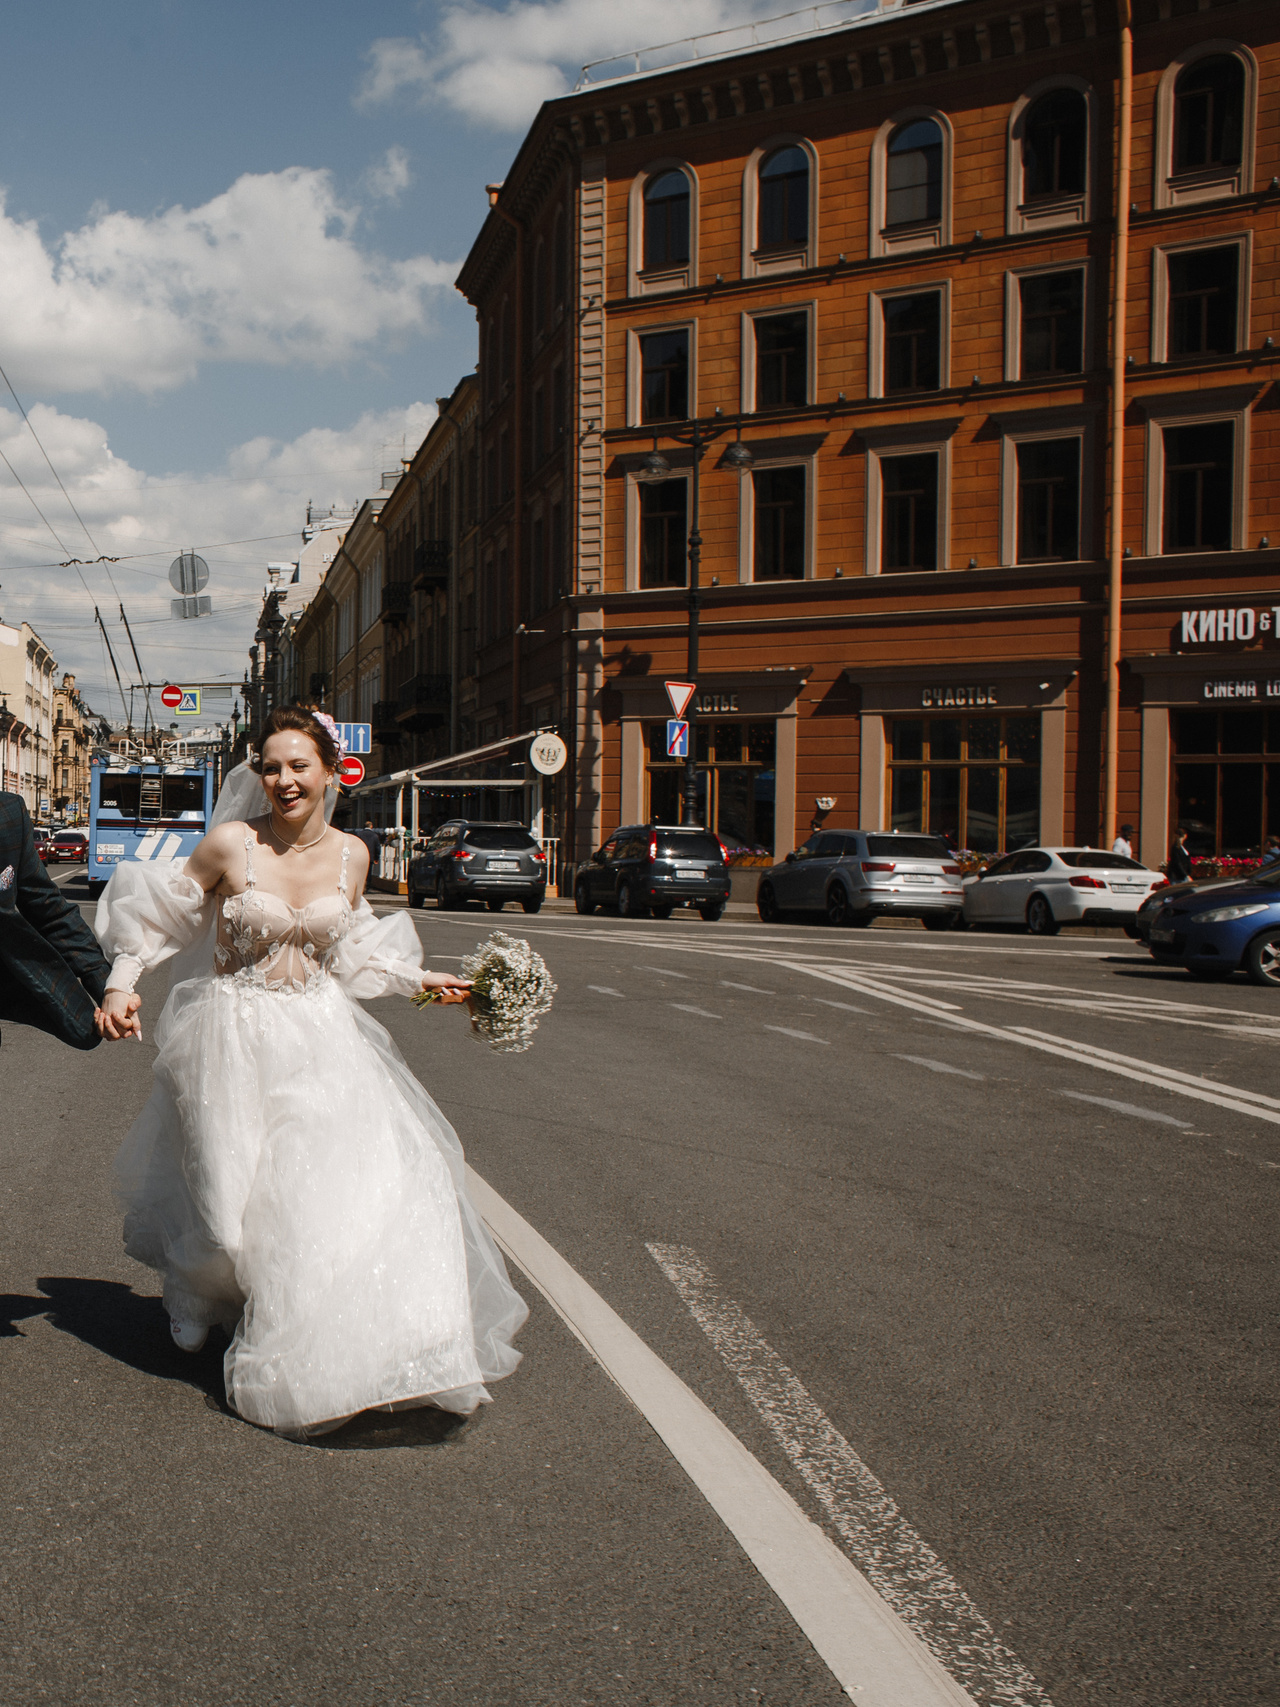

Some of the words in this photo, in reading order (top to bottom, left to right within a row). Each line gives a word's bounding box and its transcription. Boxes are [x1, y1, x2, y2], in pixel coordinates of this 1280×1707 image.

[1182, 608, 1255, 643] КИНО
[922, 686, 998, 707] СЧАСТЬЕ
[1204, 681, 1257, 698] CINEMA
[696, 695, 739, 712] АСТЬЕ
